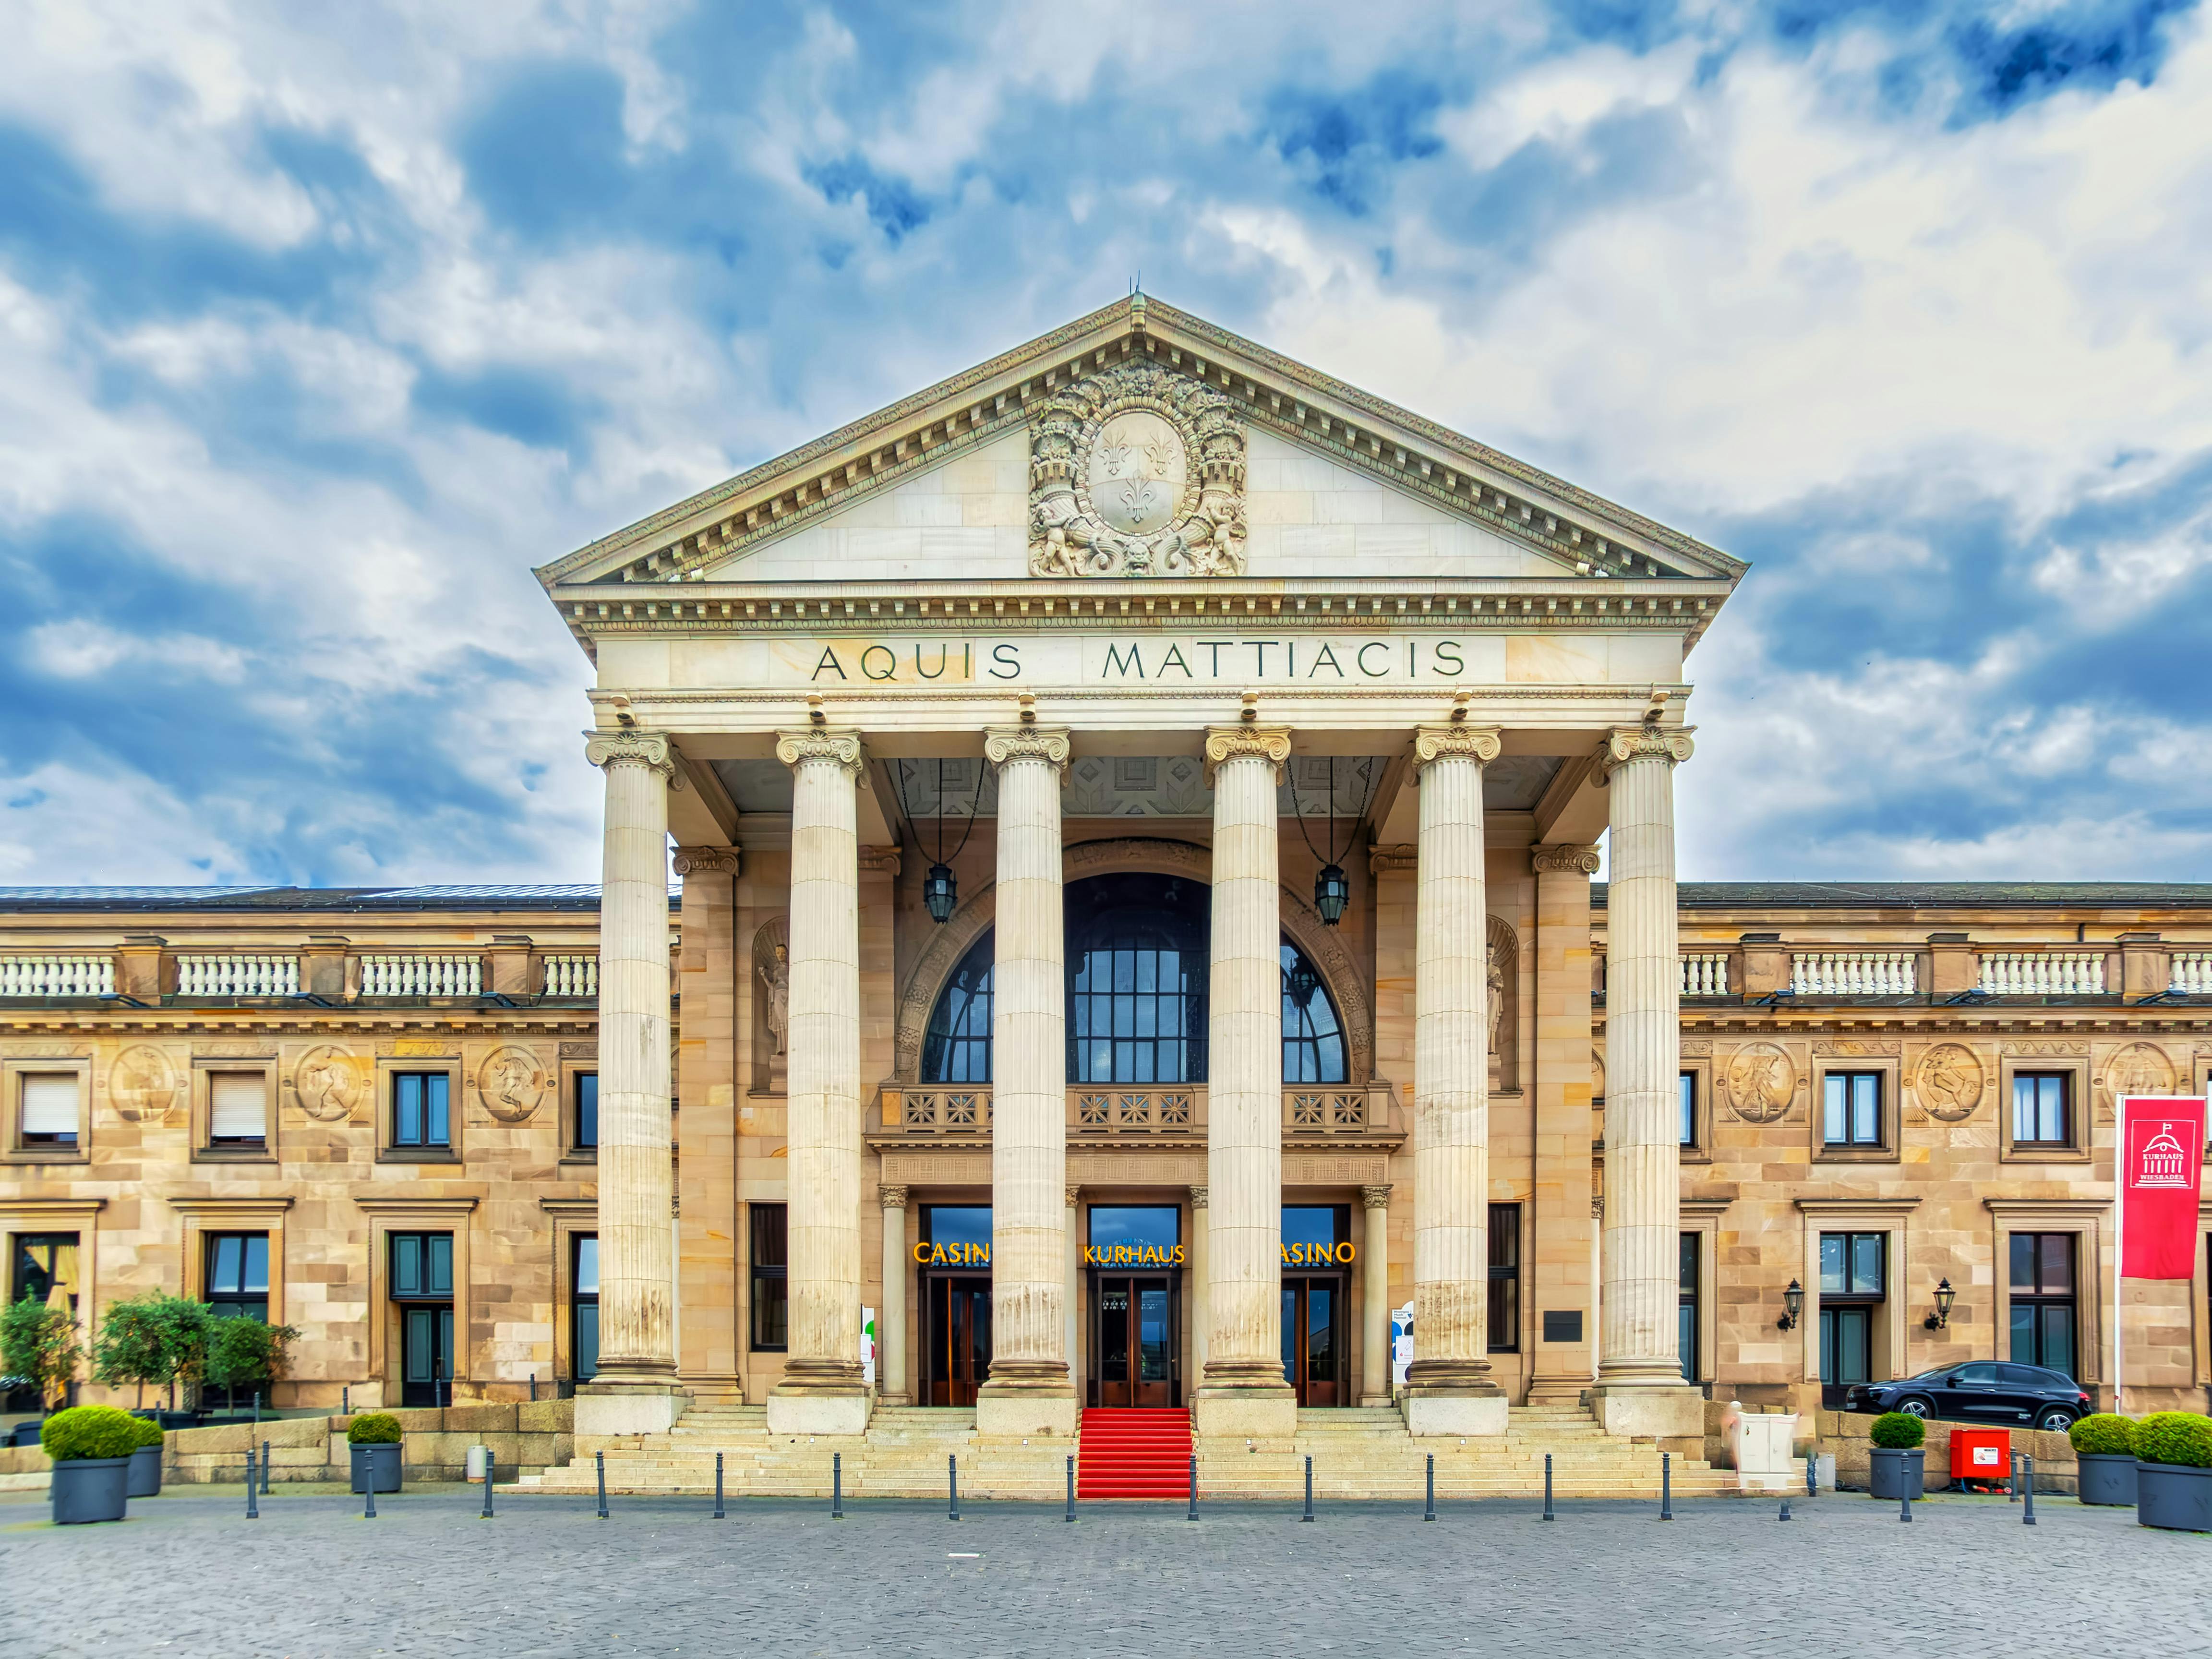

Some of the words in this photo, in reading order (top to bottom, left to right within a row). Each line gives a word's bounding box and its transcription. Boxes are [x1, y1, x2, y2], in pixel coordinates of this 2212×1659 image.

[811, 644, 1021, 681] AQUIS
[1102, 641, 1465, 678] MATTIACIS
[913, 1242, 989, 1263] CASIN
[1083, 1245, 1185, 1263] KURHAUS
[1280, 1242, 1356, 1263] ASINO
